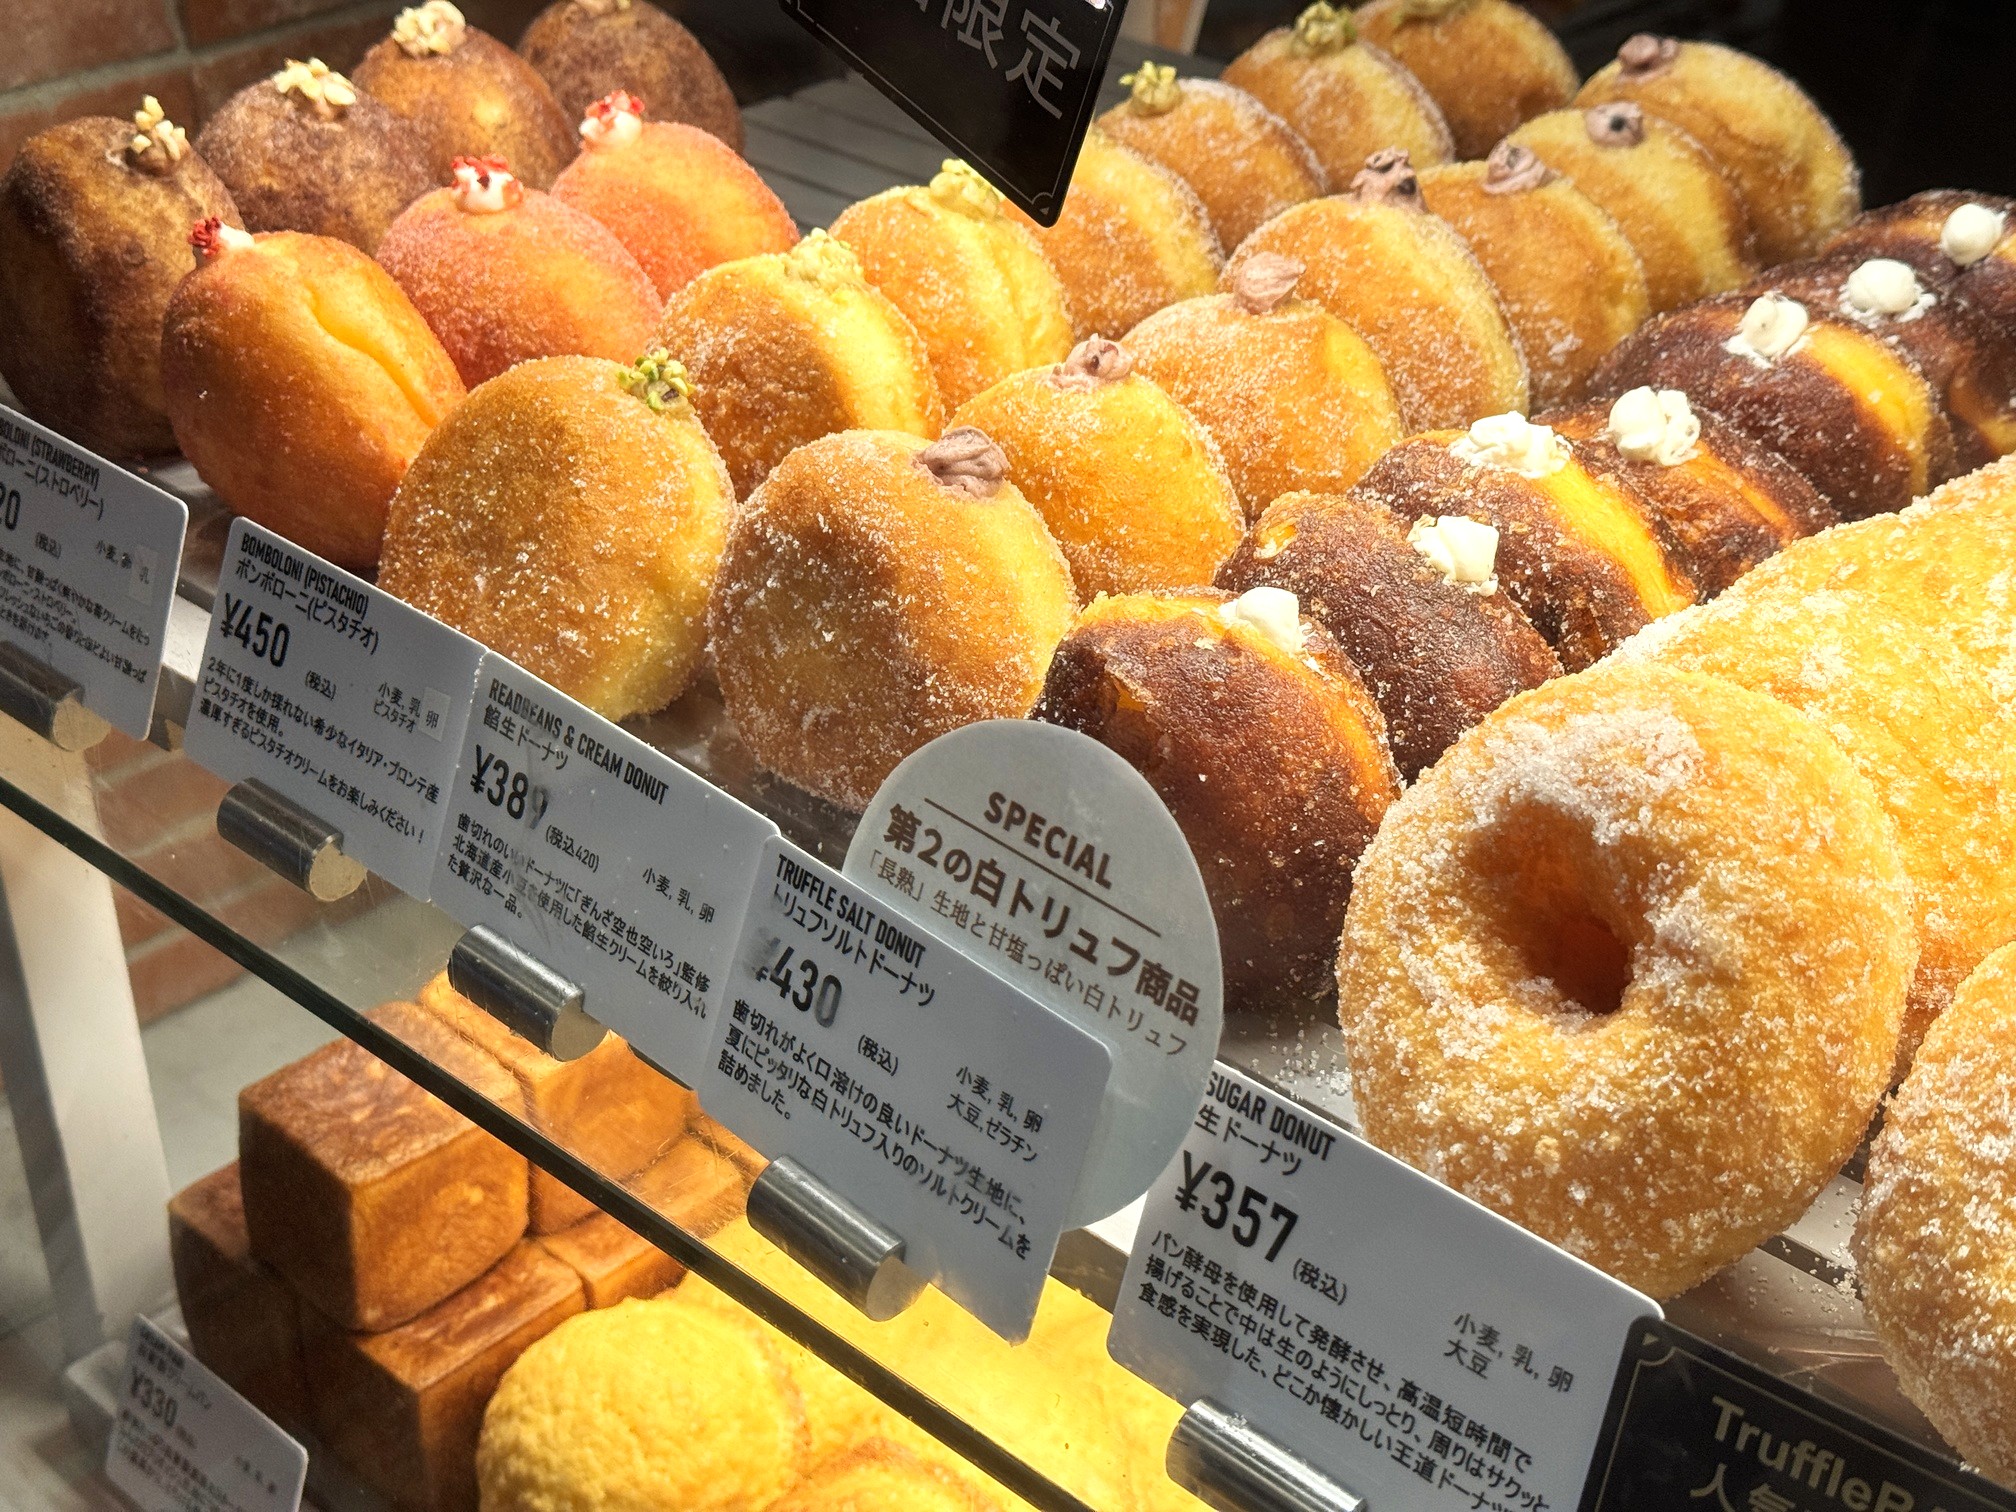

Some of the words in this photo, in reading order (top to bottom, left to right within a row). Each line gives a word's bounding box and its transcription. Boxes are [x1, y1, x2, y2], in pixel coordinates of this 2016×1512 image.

[235, 559, 379, 655] ボンボローニ(ピスタチオ)
[241, 532, 302, 578] BOMBOLONI
[304, 570, 369, 619] (PISTACHIO)
[221, 593, 291, 667] ¥450
[203, 675, 284, 737] ピスタチオを使用。
[305, 670, 338, 701] (税込)
[373, 700, 417, 734] ピスタチオ
[482, 705, 570, 771] 餡生ドーナツ
[488, 679, 564, 742] READBEANS
[563, 725, 575, 749] &
[576, 733, 624, 779] CREAM
[623, 759, 669, 806] DONUT
[470, 744, 550, 831] ¥389
[545, 824, 601, 874] (税込420)
[983, 791, 1112, 890] SPECIAL
[447, 854, 525, 920] た贅沢な一品。
[777, 853, 836, 911] TRUFFLE
[836, 889, 877, 935] SALT
[875, 913, 926, 968] DONUT
[883, 803, 1200, 1028] 第2の白トリュフ商品
[771, 889, 936, 1007] トリュフソルトドーナツ
[717, 1051, 792, 1120] 詰めました。
[858, 1035, 899, 1076] (税込)
[1195, 1104, 1303, 1178] 生ドーナツ
[1205, 1071, 1267, 1127] SUGAR
[1269, 1104, 1336, 1163] DONUT
[1174, 1149, 1300, 1263] ¥357
[1293, 1257, 1348, 1306] (税込)
[1152, 1230, 1533, 1473] パン酵母を使用して発酵させ、高温短時間で
[1443, 1337, 1489, 1380] 大豆
